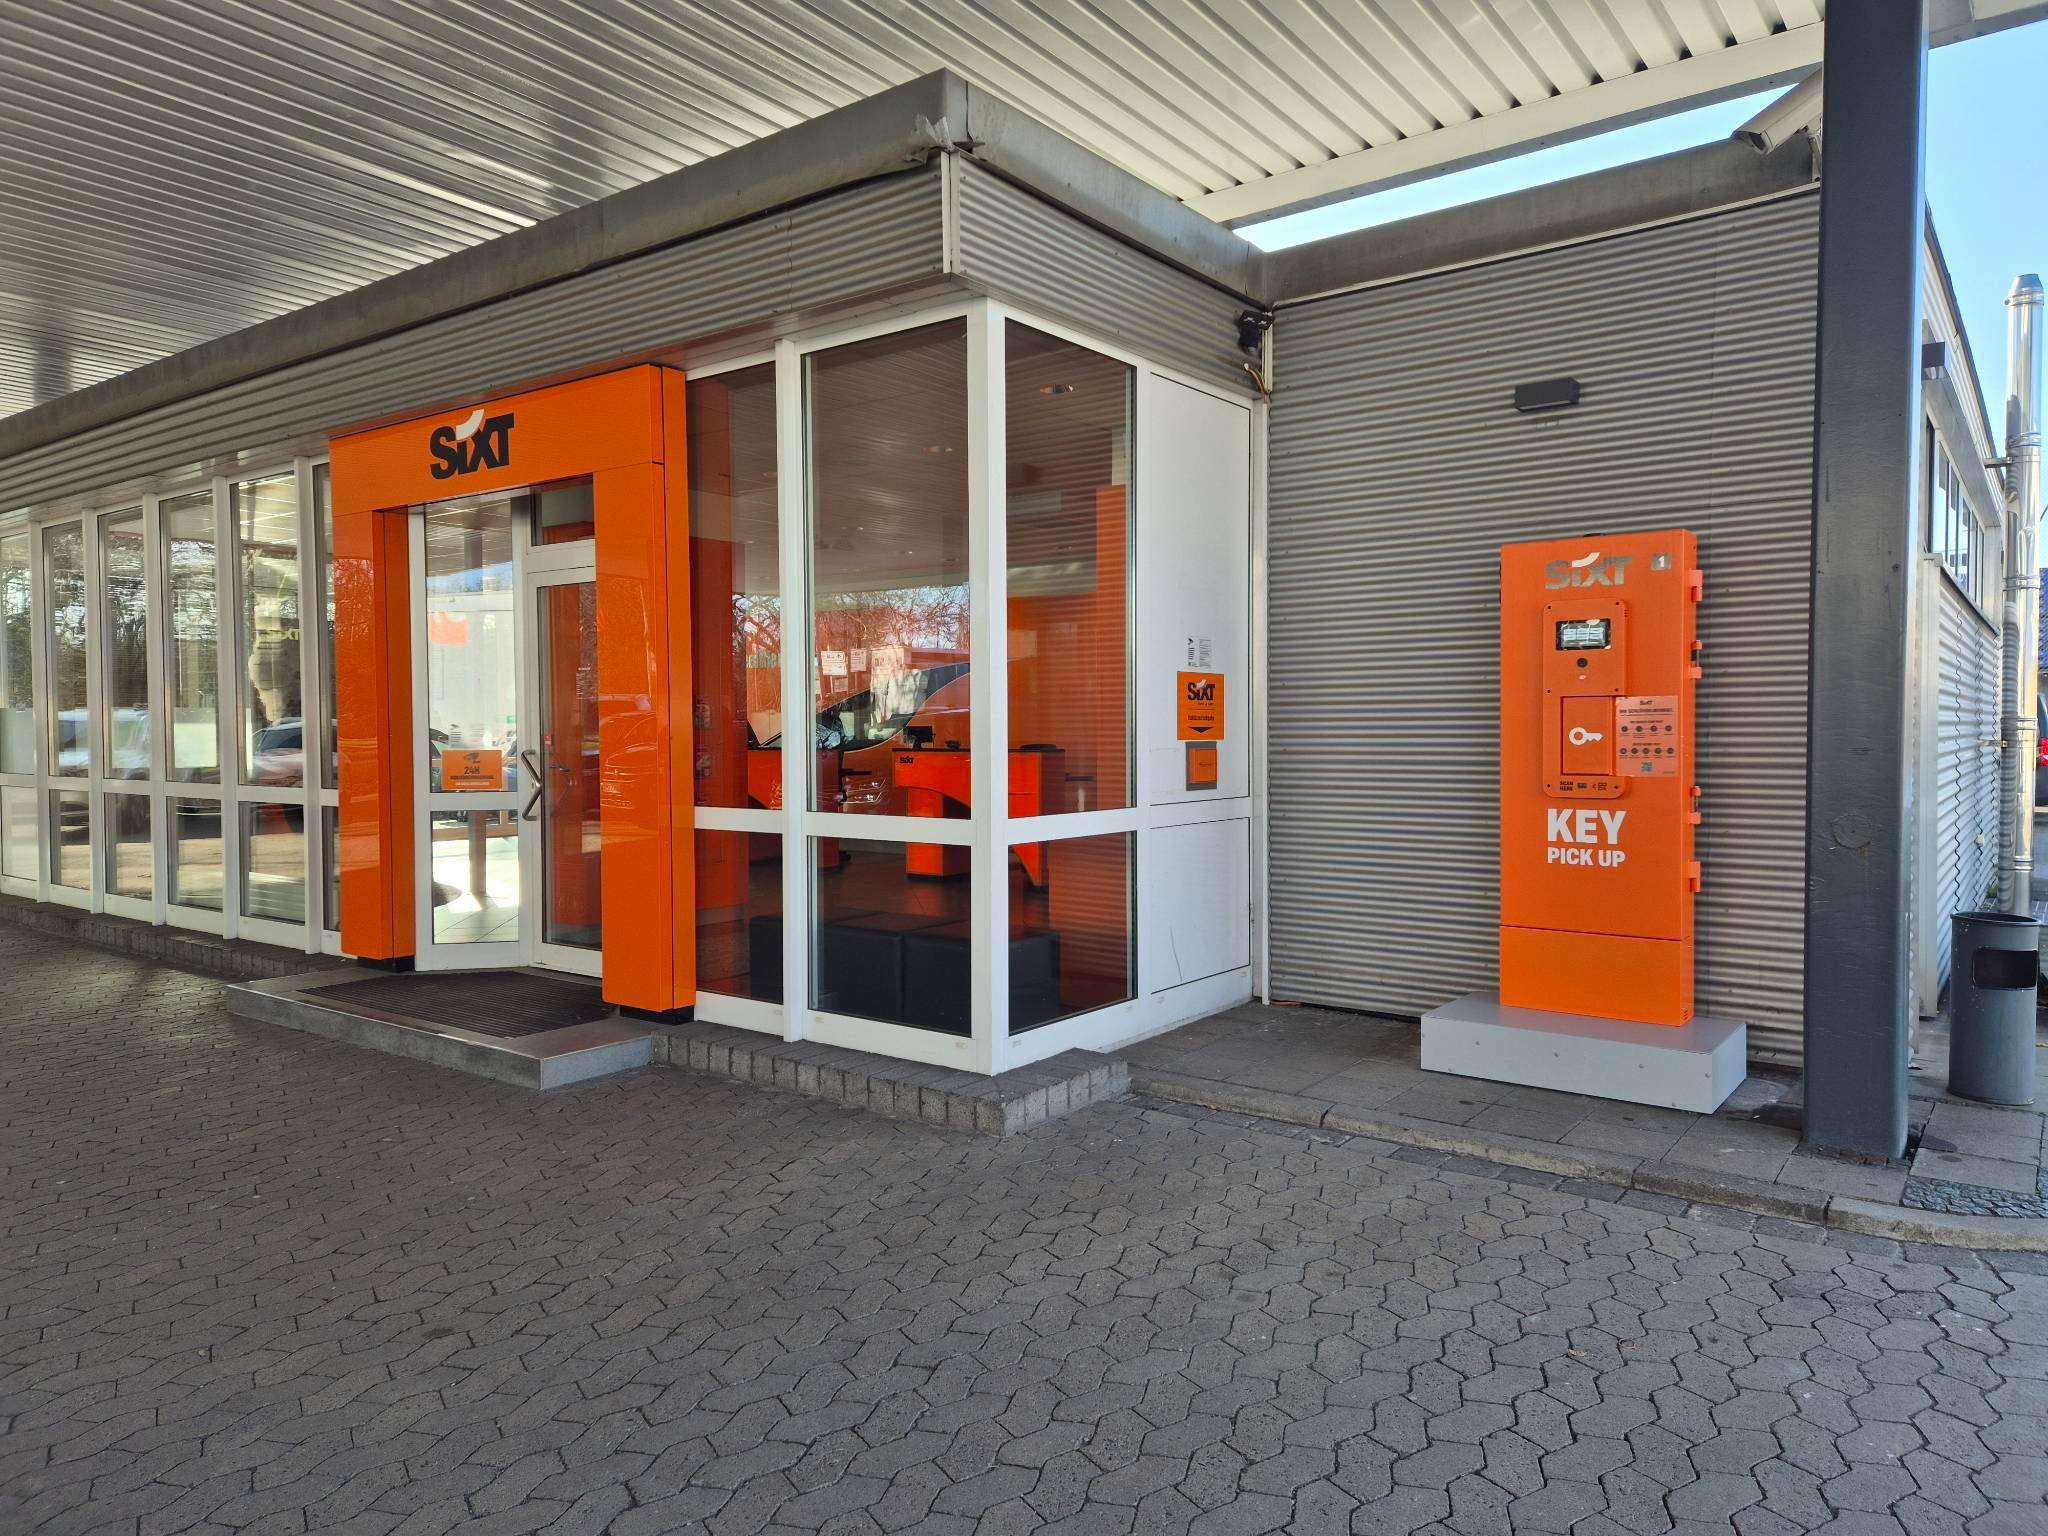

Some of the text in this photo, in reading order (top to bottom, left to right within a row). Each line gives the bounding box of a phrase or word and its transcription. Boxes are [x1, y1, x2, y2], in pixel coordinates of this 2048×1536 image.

[1547, 807, 1627, 845] KEY
[1547, 846, 1626, 868] PICK UP
